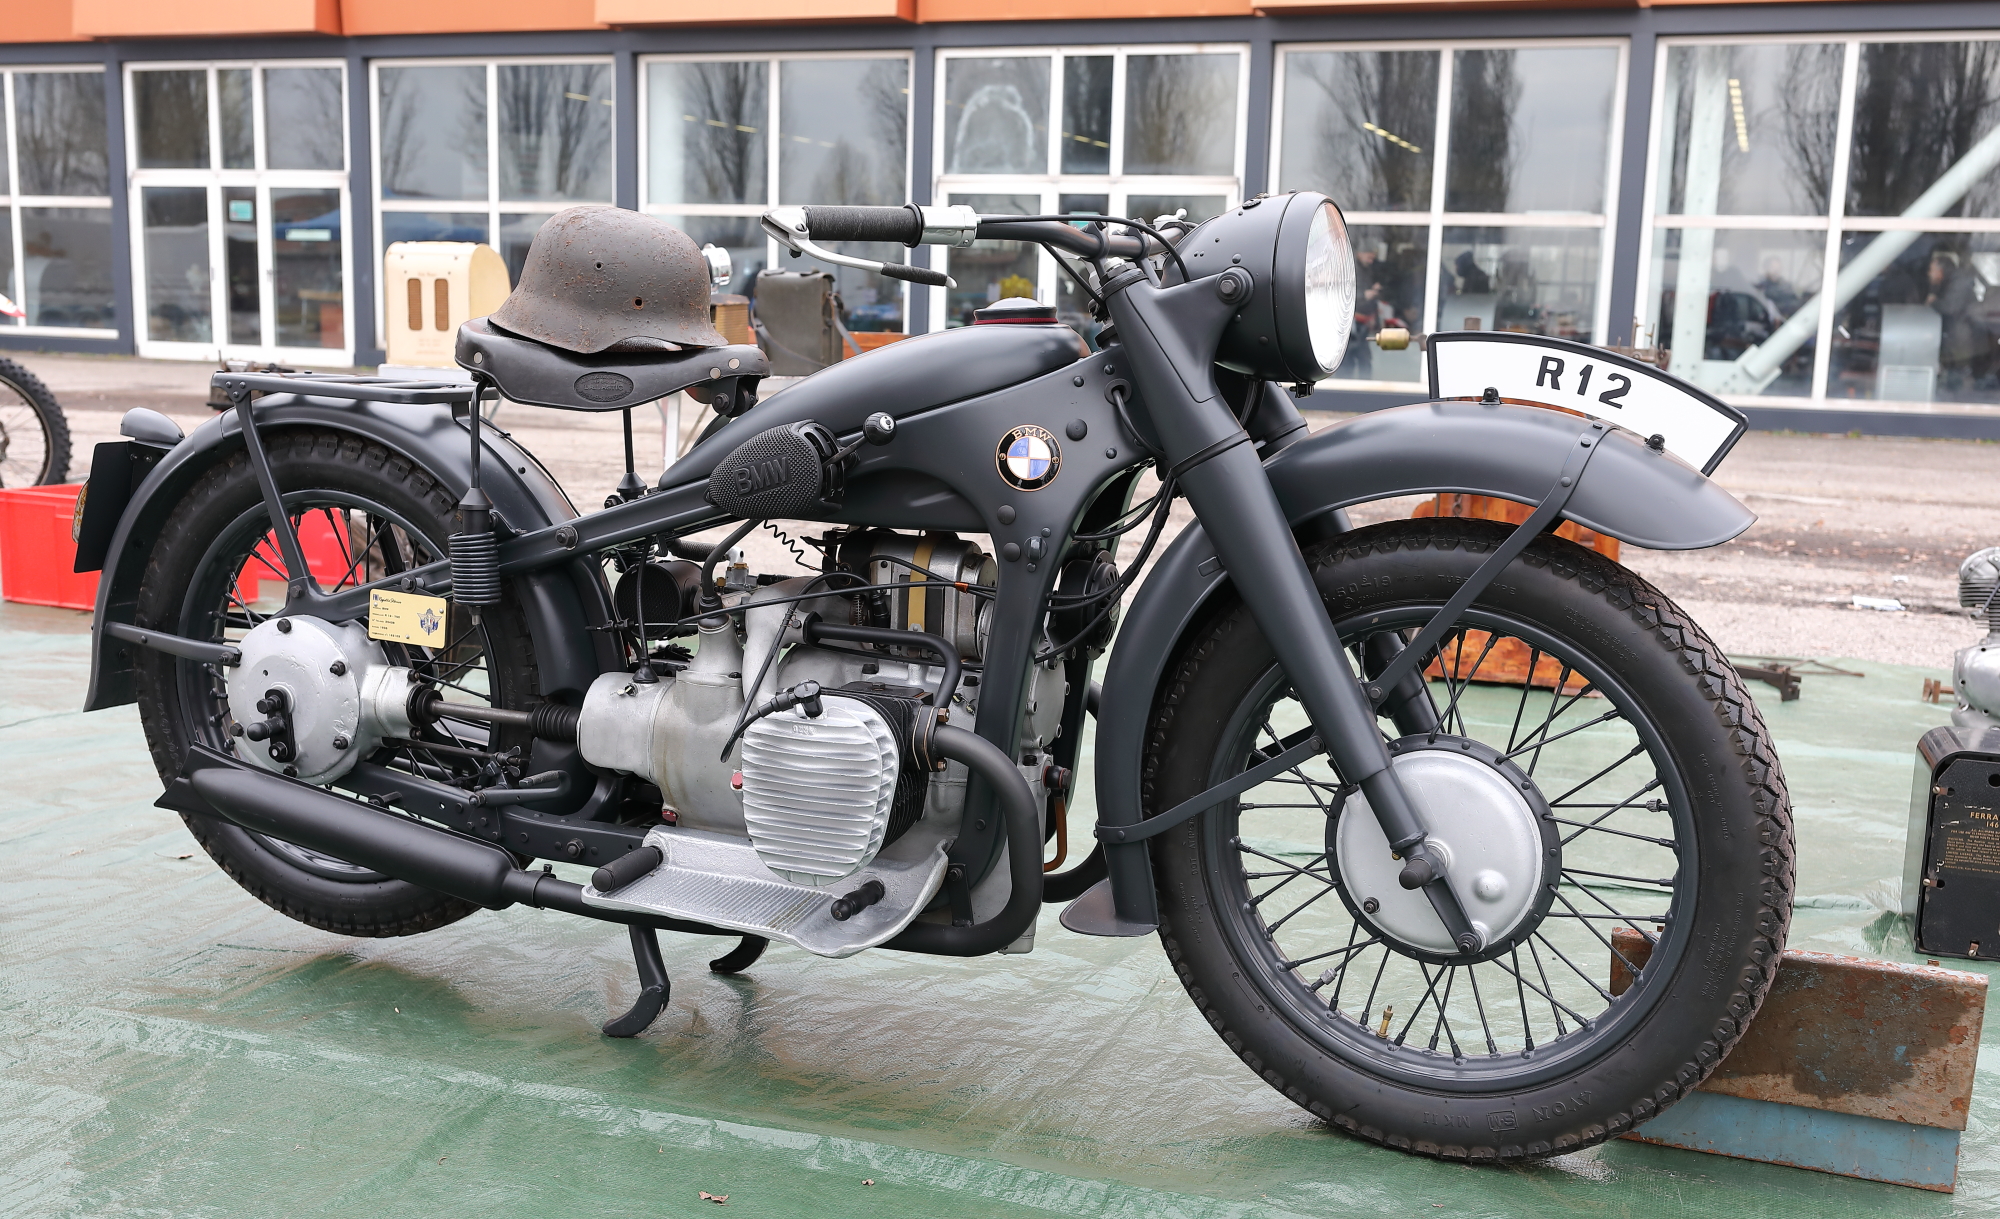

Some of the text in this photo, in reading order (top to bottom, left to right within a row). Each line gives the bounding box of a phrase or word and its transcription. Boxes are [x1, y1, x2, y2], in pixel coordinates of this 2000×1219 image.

[1011, 427, 1052, 442] BMW
[734, 456, 788, 496] BMW
[1531, 1090, 1593, 1123] AVON
